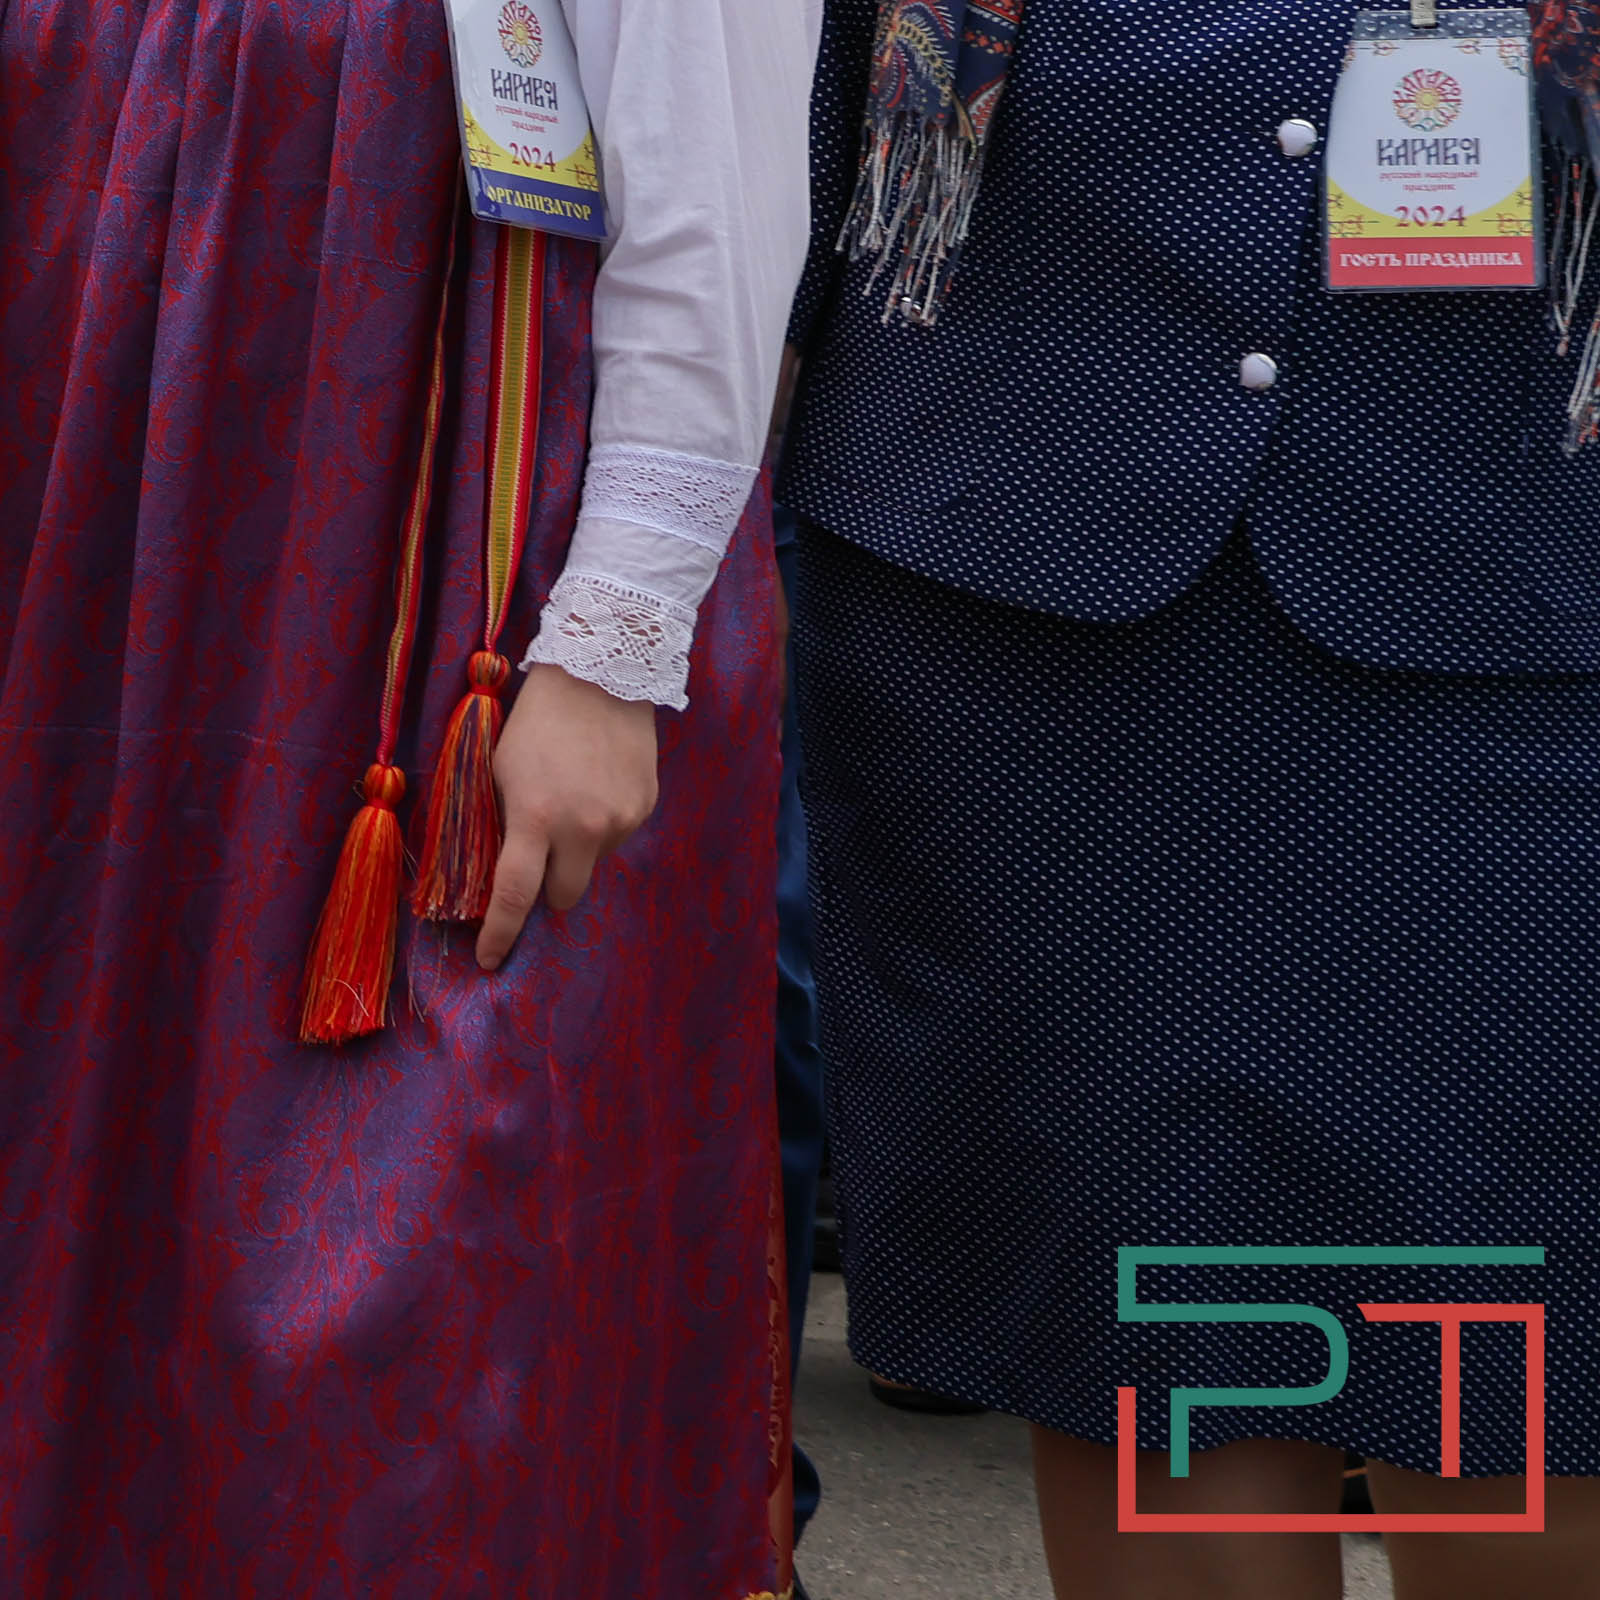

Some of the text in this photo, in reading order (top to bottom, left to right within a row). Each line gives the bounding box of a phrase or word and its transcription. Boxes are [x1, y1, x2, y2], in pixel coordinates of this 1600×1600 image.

[491, 69, 558, 110] КАРАВОН
[509, 142, 556, 172] 2024
[1377, 138, 1480, 166] КАРАВОН
[487, 185, 592, 221] ОРГАНИЗАТОР
[1395, 205, 1467, 227] 2024
[1339, 252, 1523, 268] ГОСТЬ ПРАЗДНИКА
